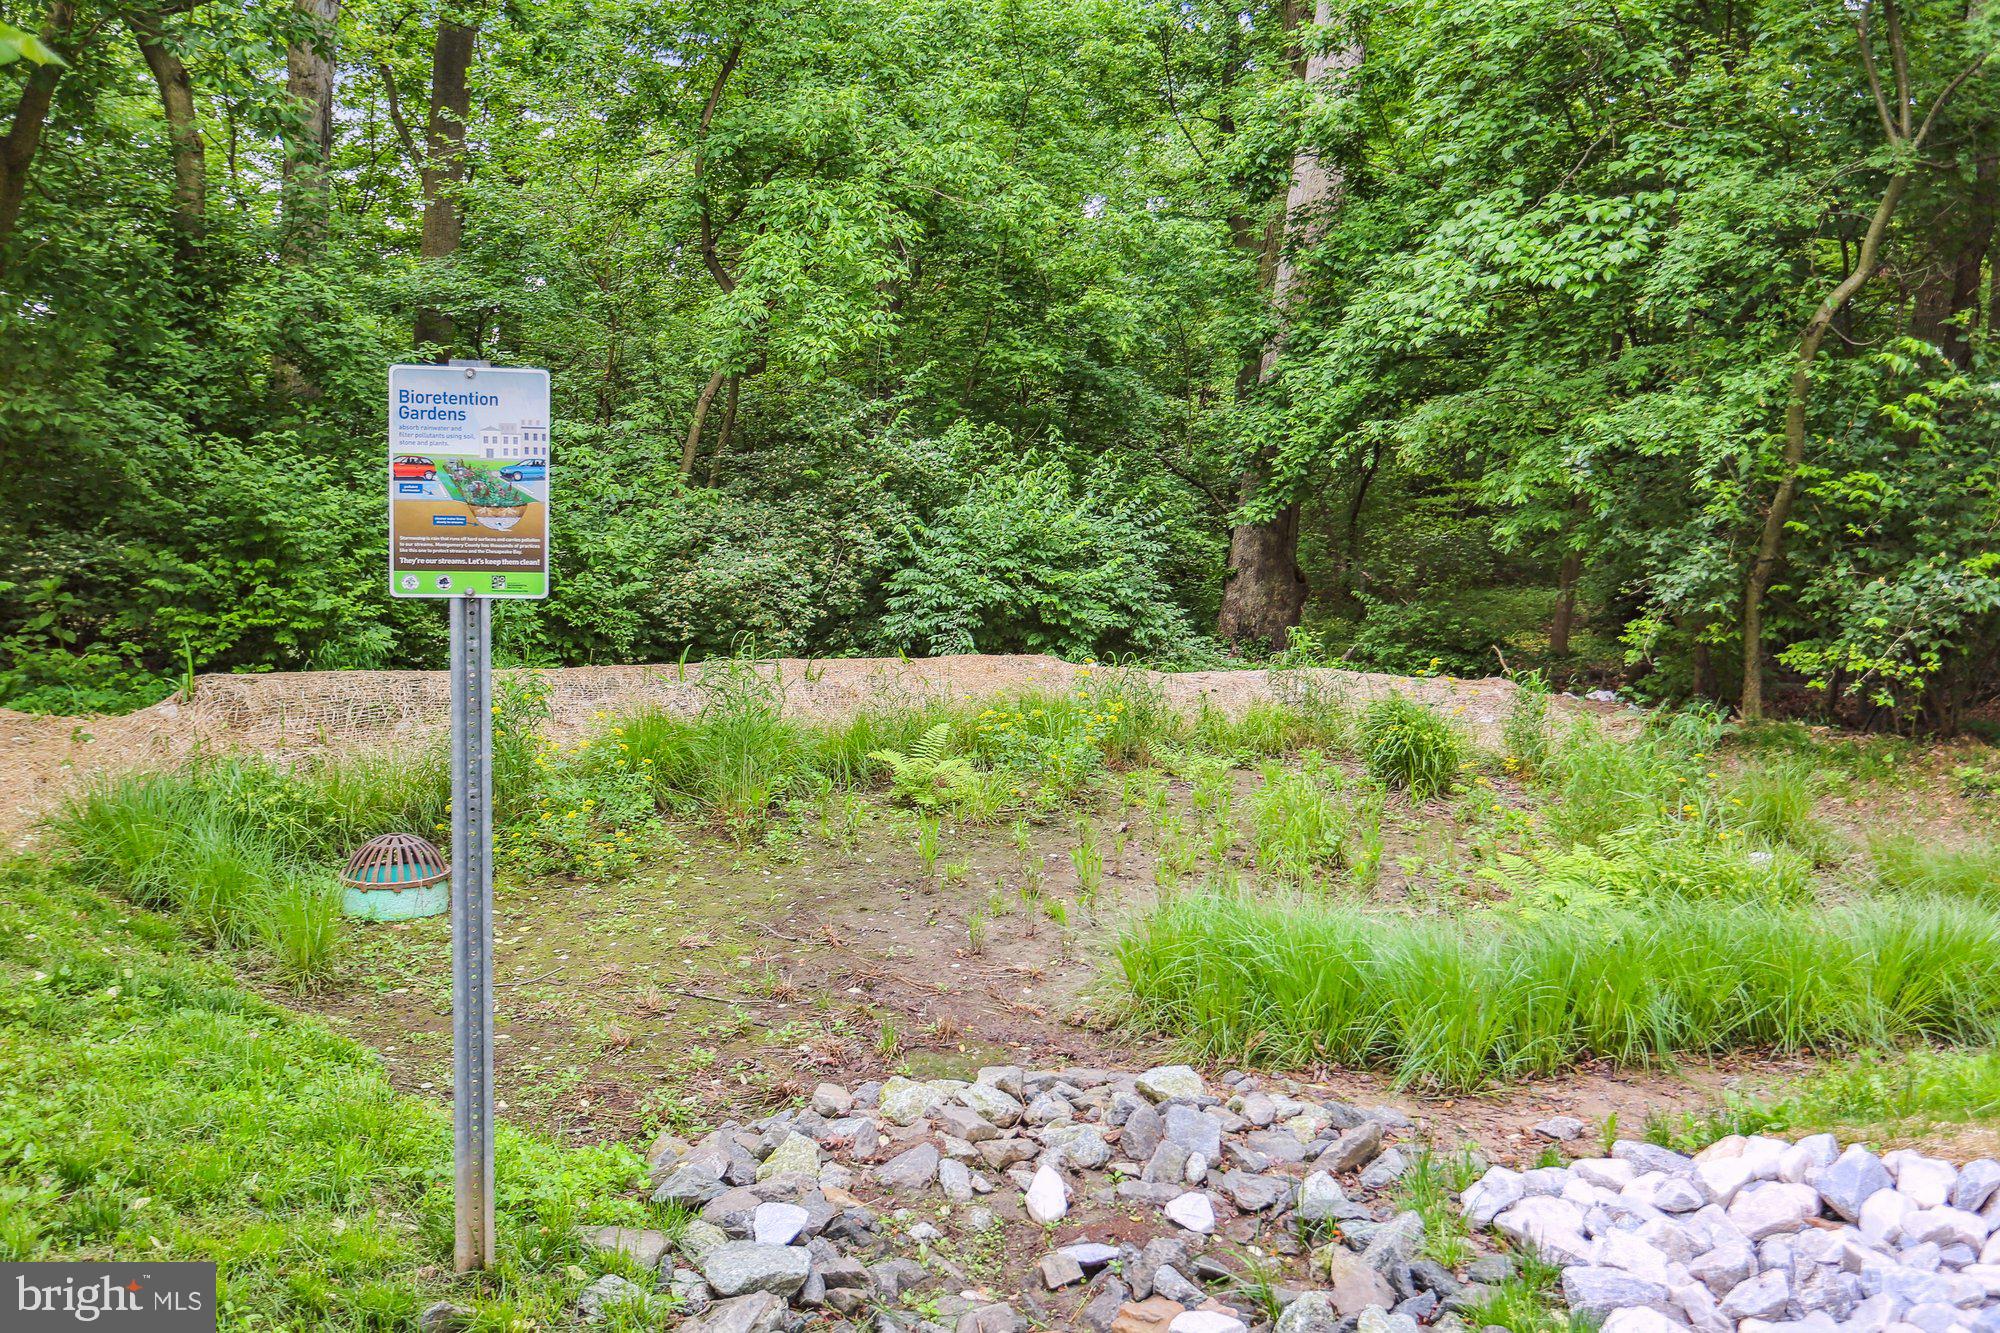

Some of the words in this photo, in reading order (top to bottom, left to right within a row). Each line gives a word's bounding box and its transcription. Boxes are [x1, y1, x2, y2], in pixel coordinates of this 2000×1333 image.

[399, 389, 499, 406] Bioretention
[399, 406, 466, 421] Gardens
[399, 557, 425, 565] They're
